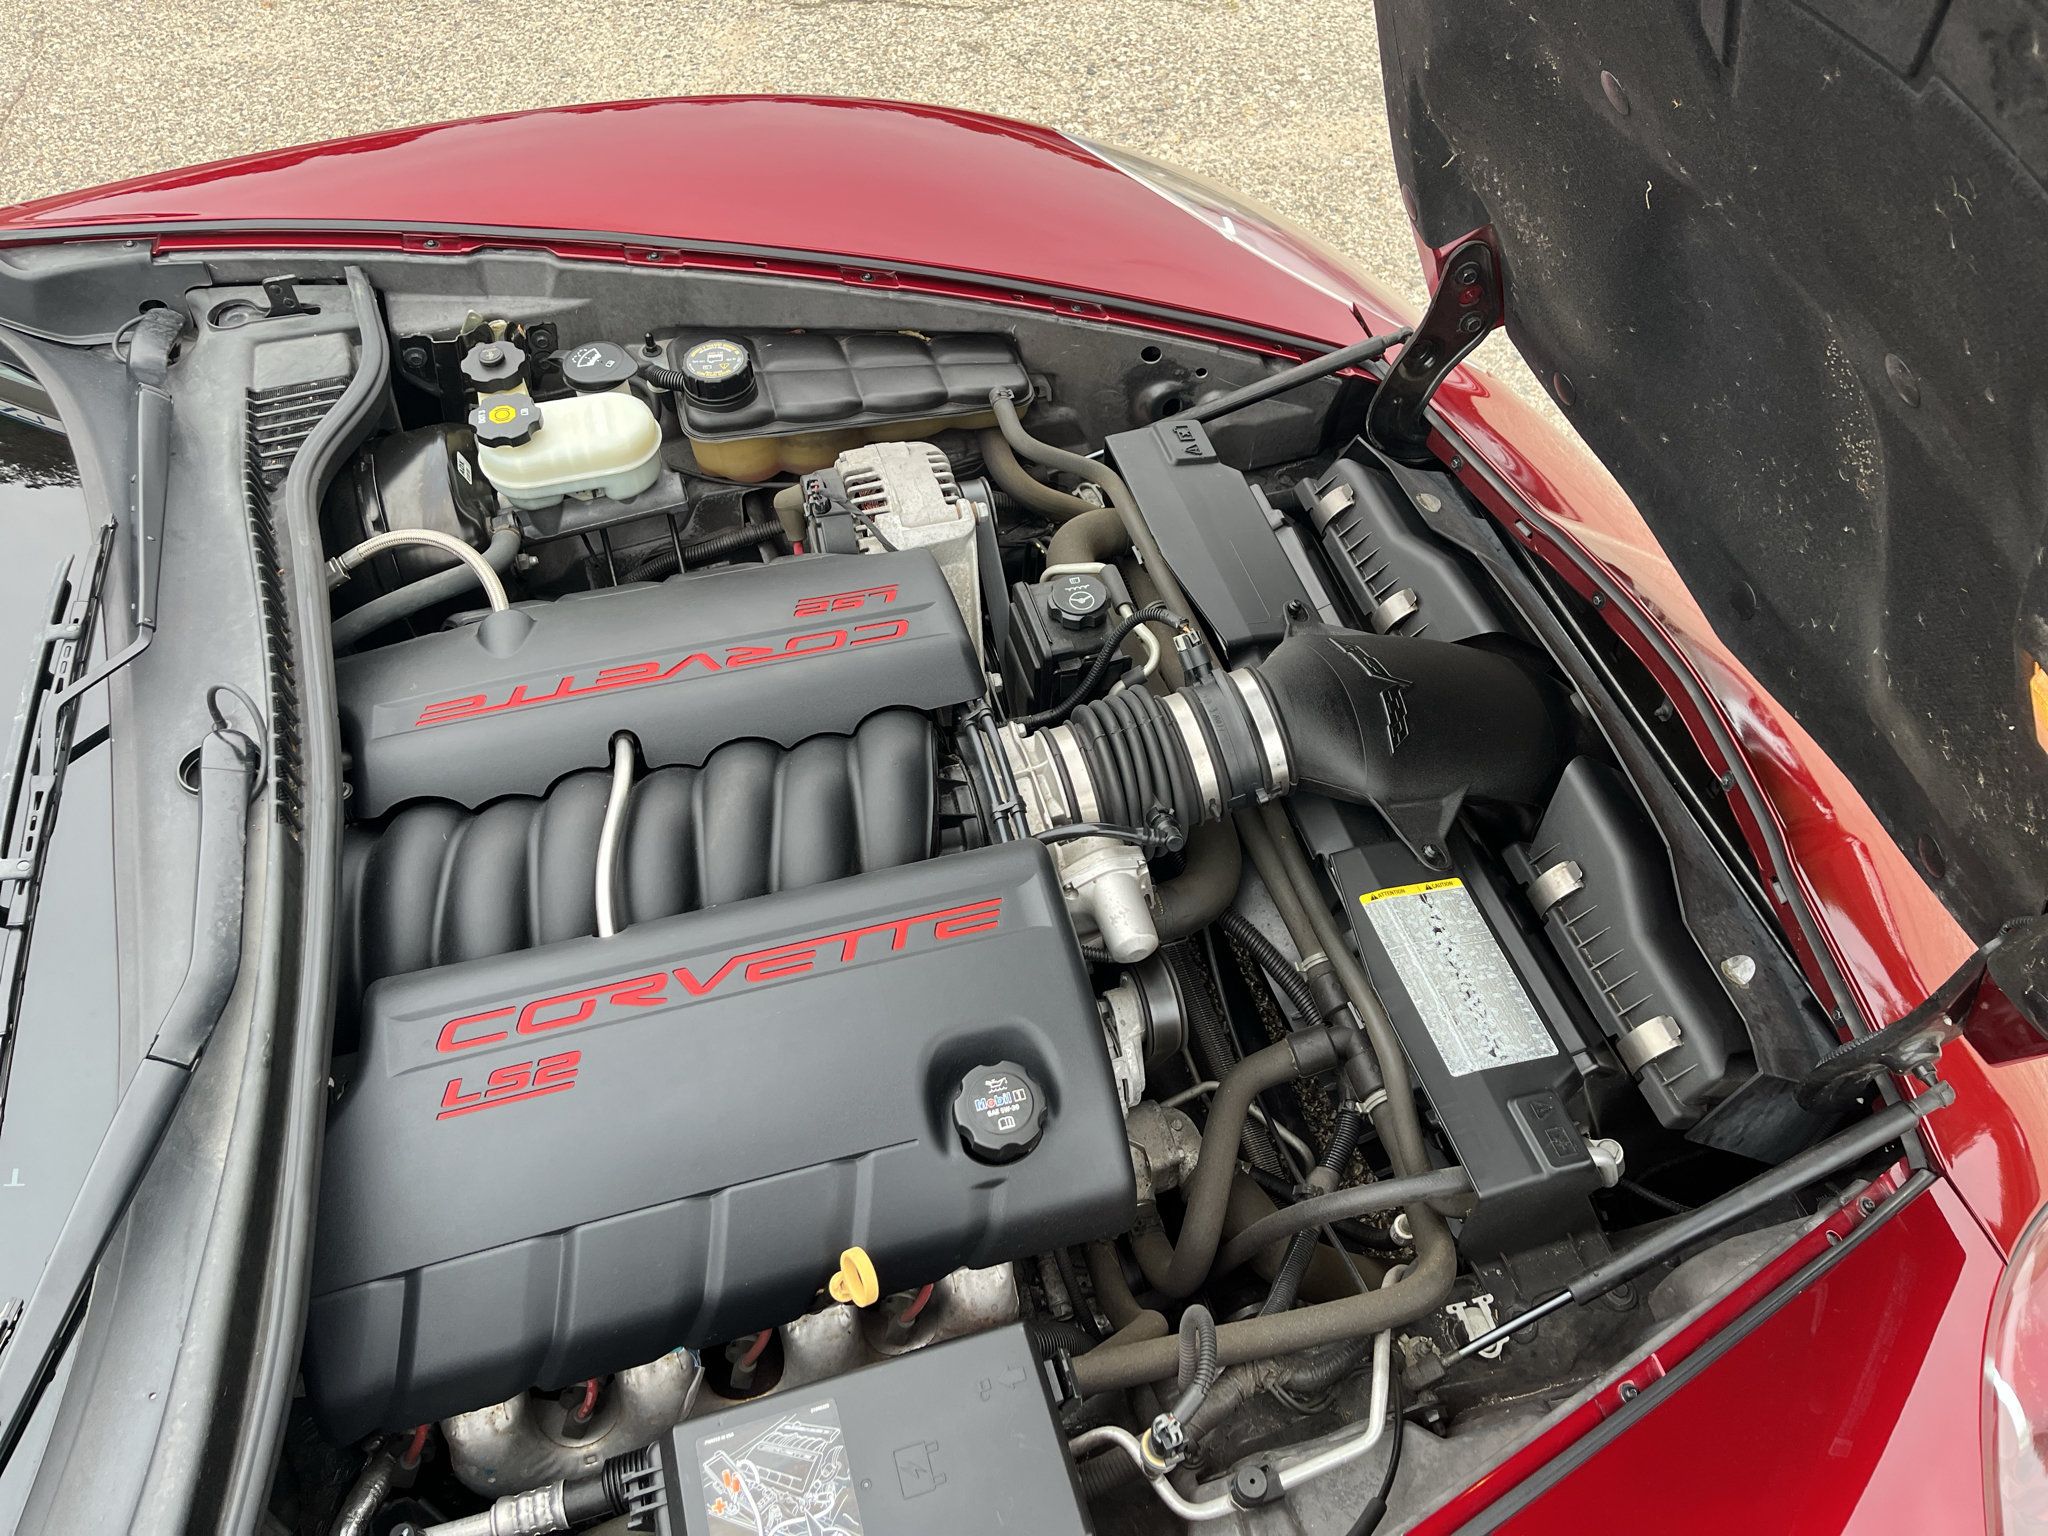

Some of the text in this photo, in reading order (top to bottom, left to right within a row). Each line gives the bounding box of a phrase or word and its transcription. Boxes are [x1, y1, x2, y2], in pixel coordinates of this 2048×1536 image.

[793, 584, 898, 618] LS2
[415, 618, 910, 727] CORVETTE
[1377, 888, 1406, 899] ATTENTION
[1431, 880, 1454, 890] CAUTION
[436, 897, 1003, 1053] CORVETTE
[438, 1050, 582, 1112] LS2
[975, 1092, 1012, 1111] Mobil
[987, 1108, 1000, 1118] SAE
